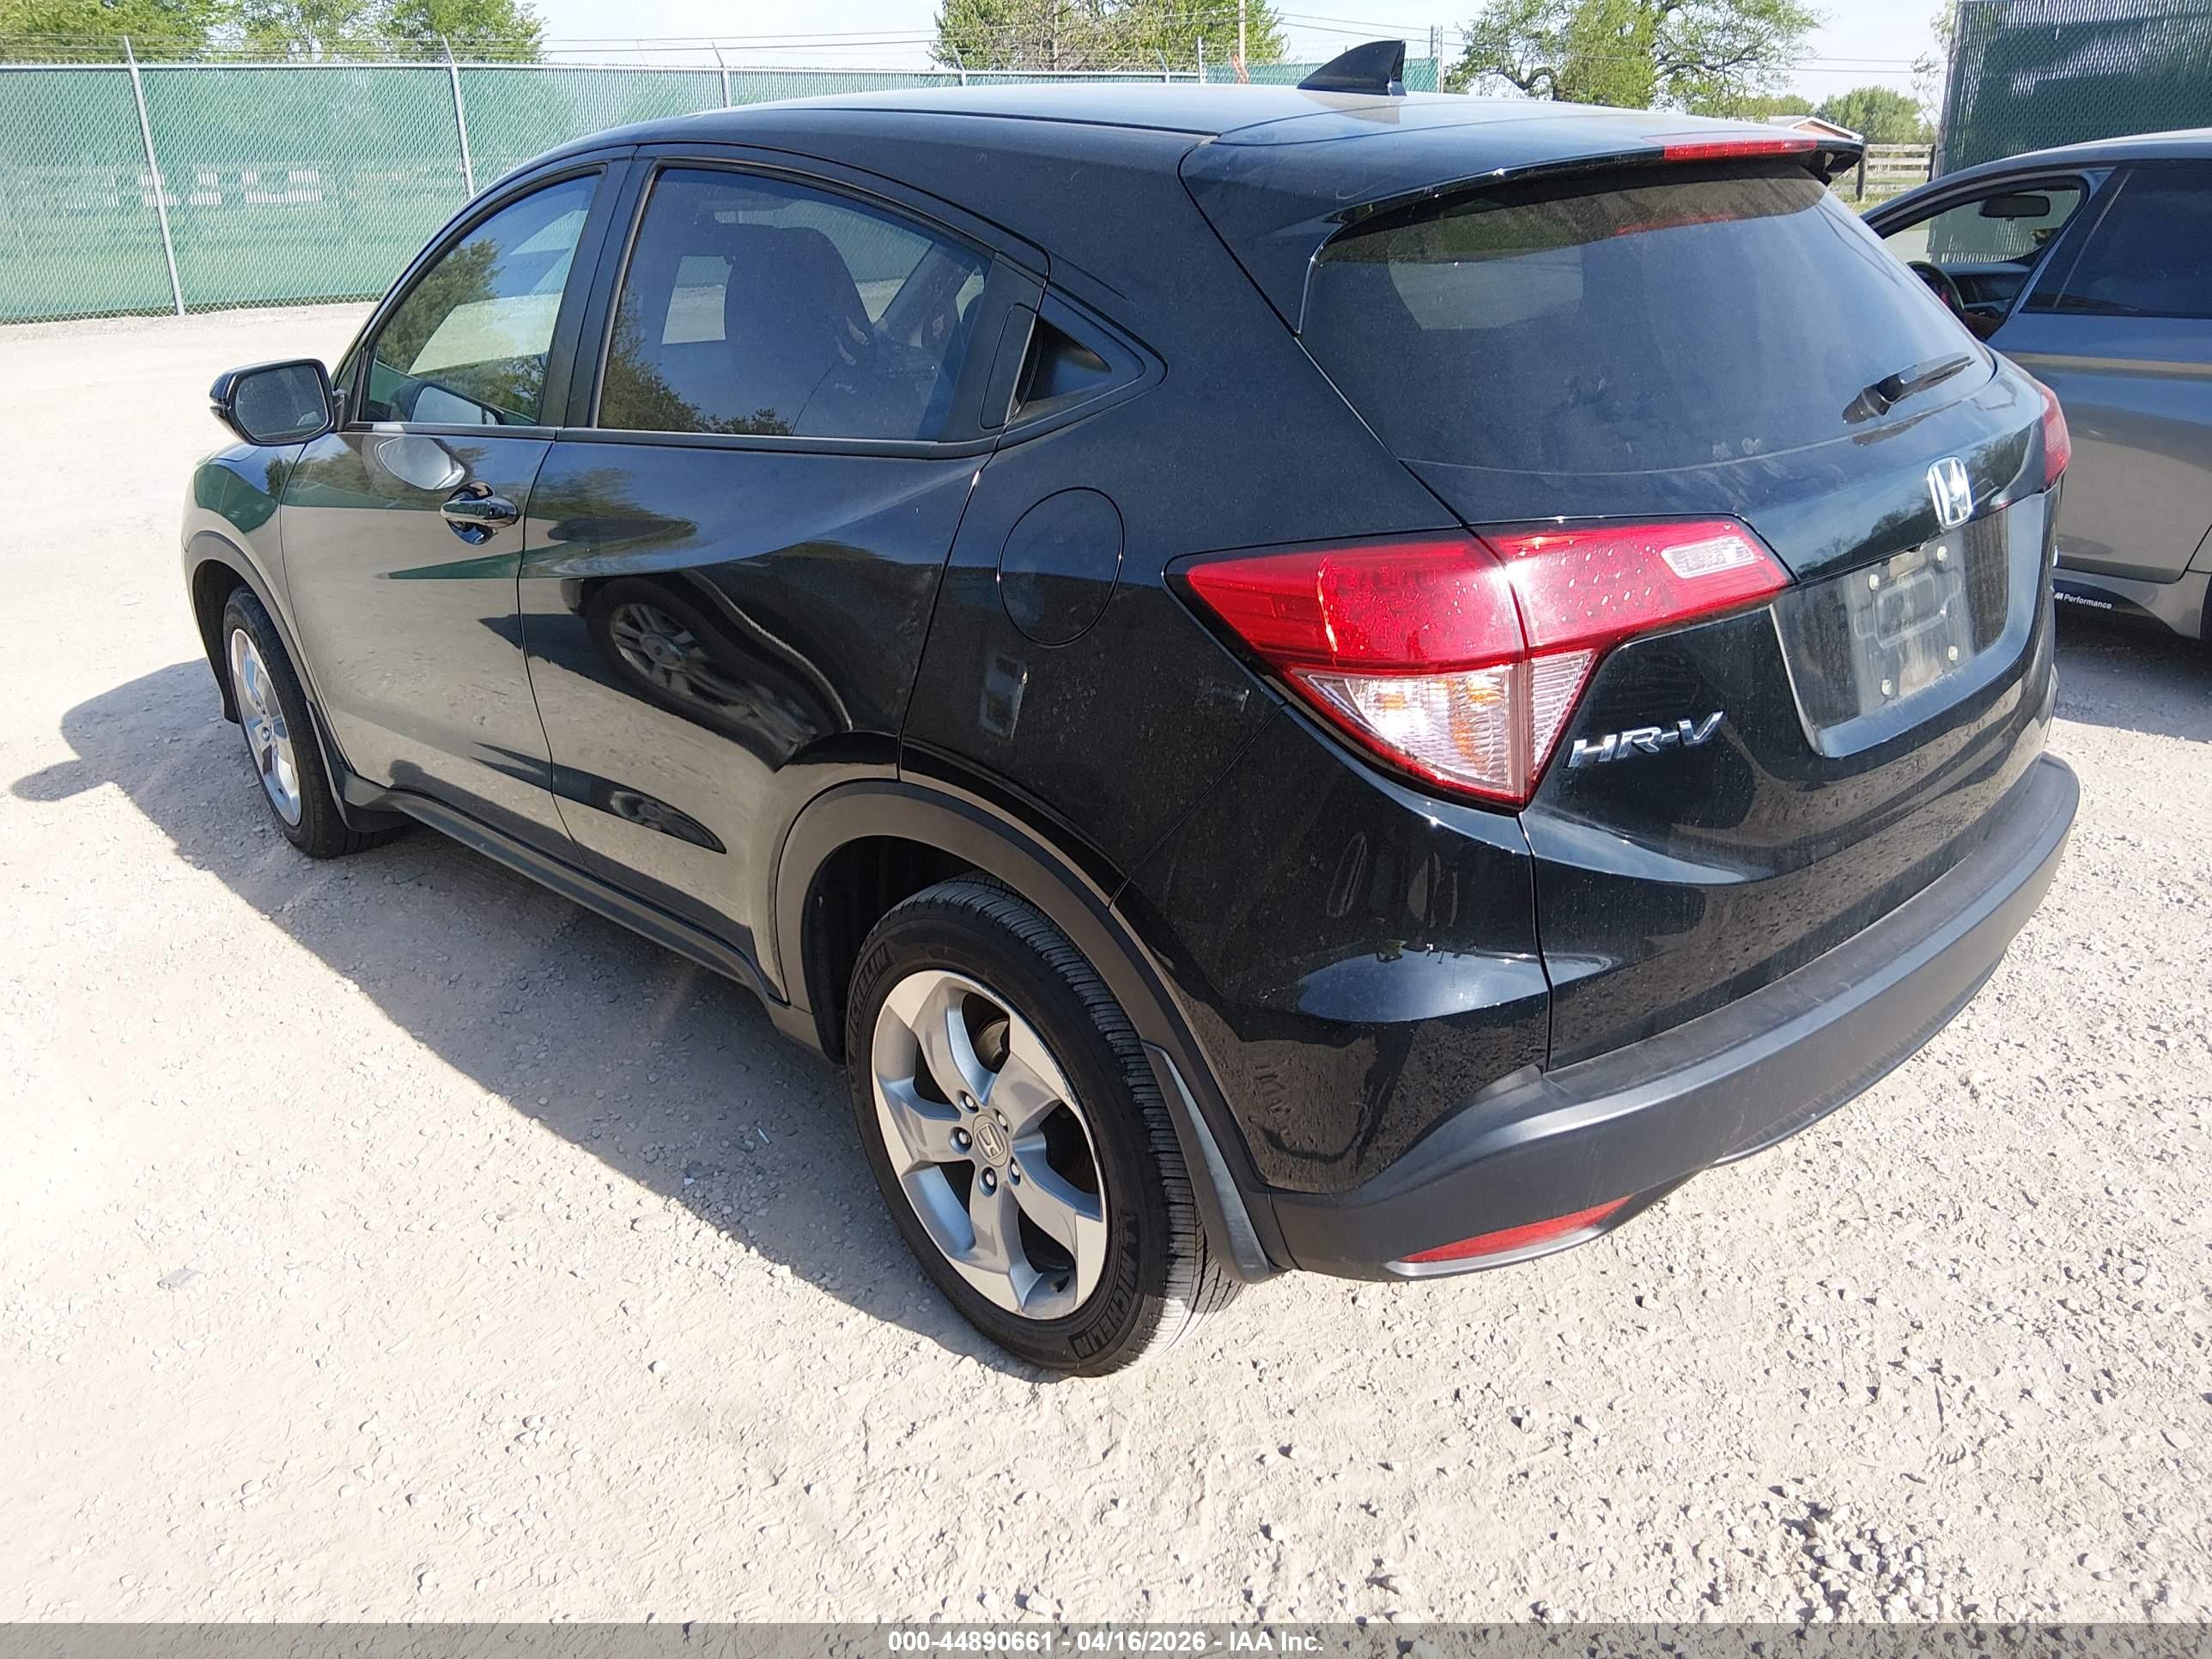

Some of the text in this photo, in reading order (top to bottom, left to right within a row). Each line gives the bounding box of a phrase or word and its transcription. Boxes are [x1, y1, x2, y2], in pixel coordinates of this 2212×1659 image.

[2064, 593, 2112, 610] Performance
[1567, 711, 1723, 769] HR-V
[1073, 1249, 1139, 1360] MICHELIN
